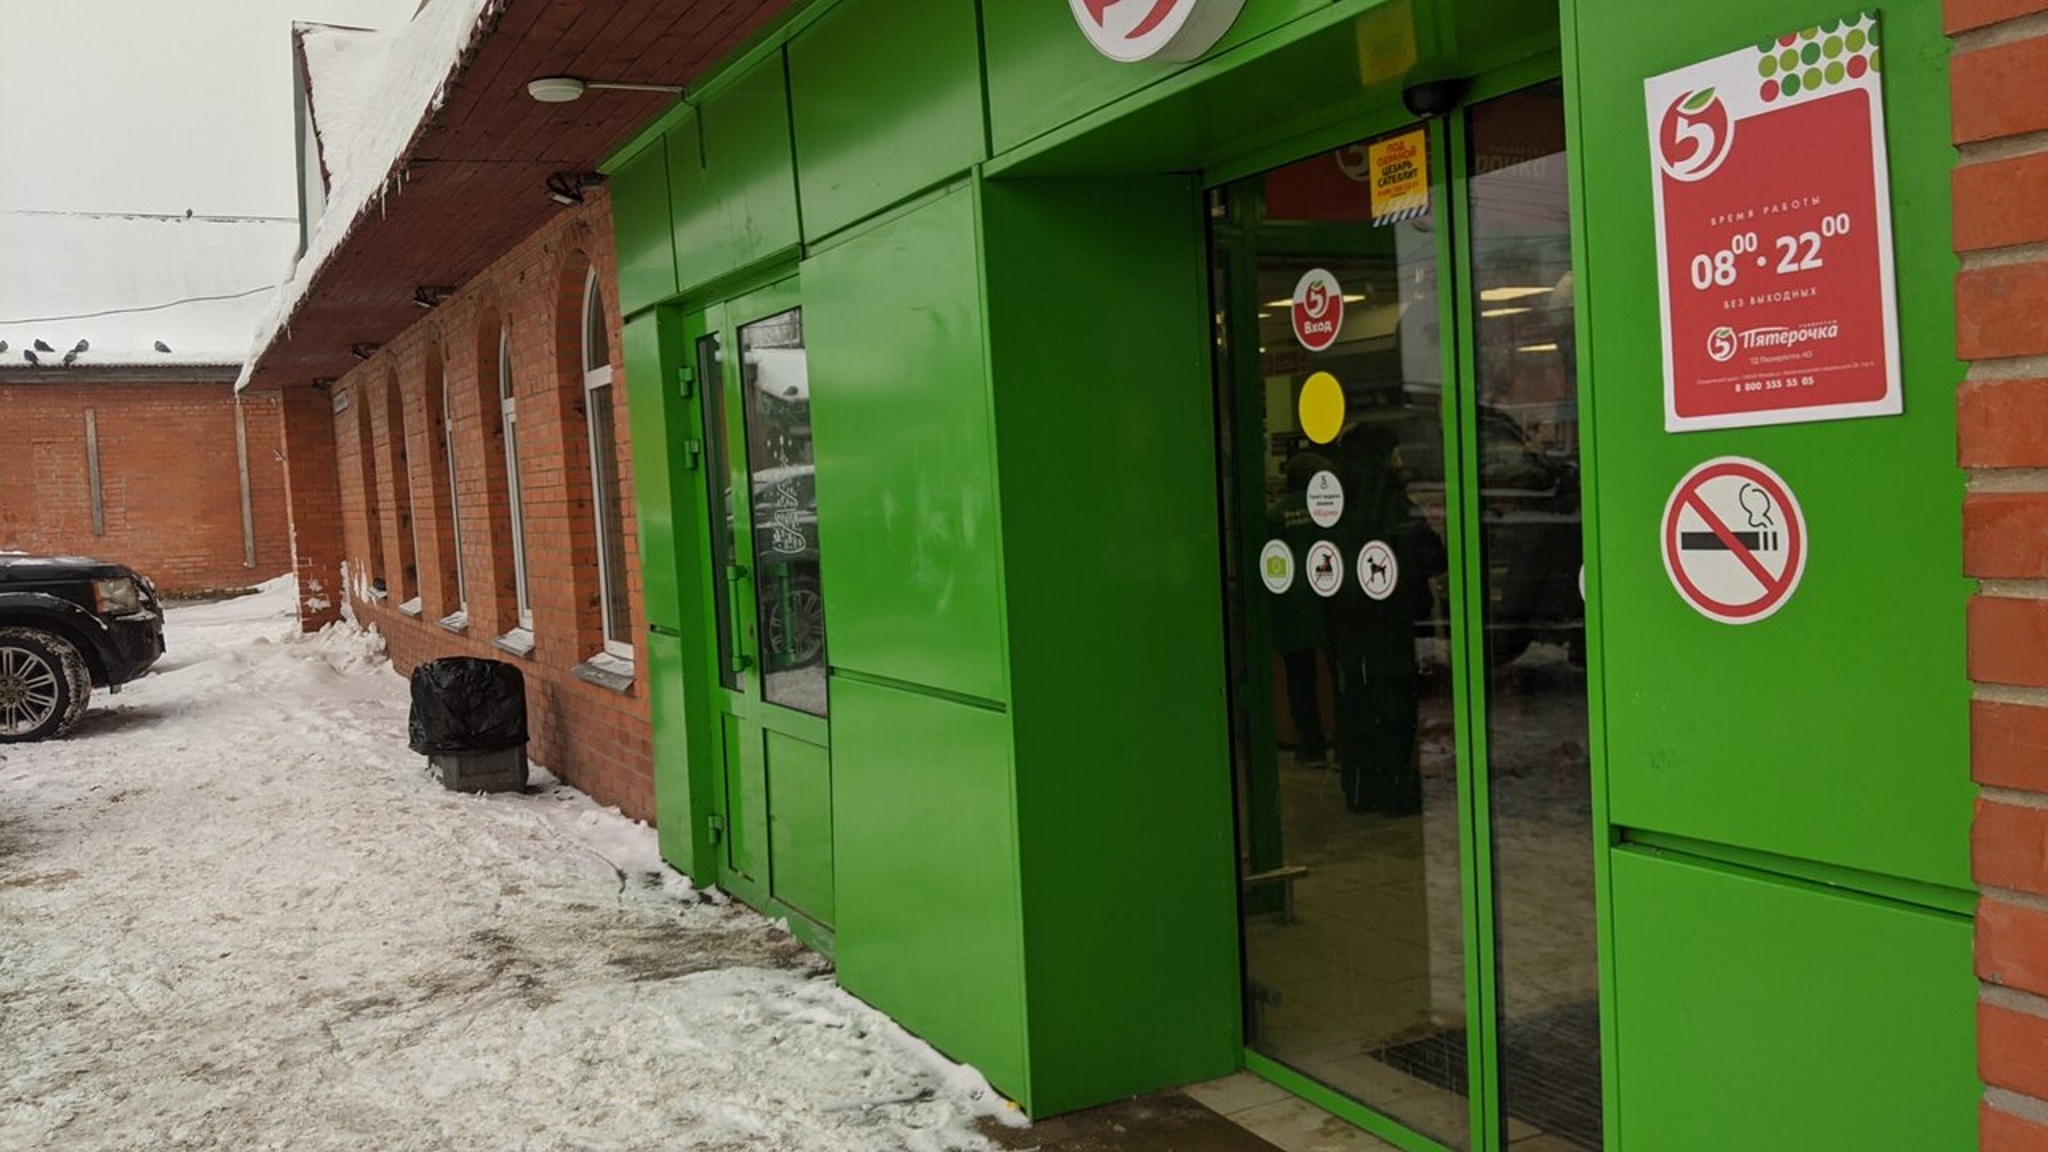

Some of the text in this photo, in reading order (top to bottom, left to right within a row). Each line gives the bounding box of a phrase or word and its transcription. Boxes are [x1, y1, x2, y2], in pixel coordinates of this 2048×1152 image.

[1378, 168, 1418, 187] САТЕЛЛИТ
[1382, 160, 1412, 176] ЦЕЗАРЬ
[1711, 196, 1821, 226] ВРЕМЯ РАБОТЫ
[1724, 287, 1817, 309] БЕЗ ВЫХОДНЫХ
[1304, 321, 1332, 335] Вход
[1738, 324, 1839, 348] Пятерочка
[1735, 384, 1741, 392] 8
[1745, 381, 1762, 391] 800
[1766, 379, 1782, 389] 555
[1786, 377, 1798, 387] 55
